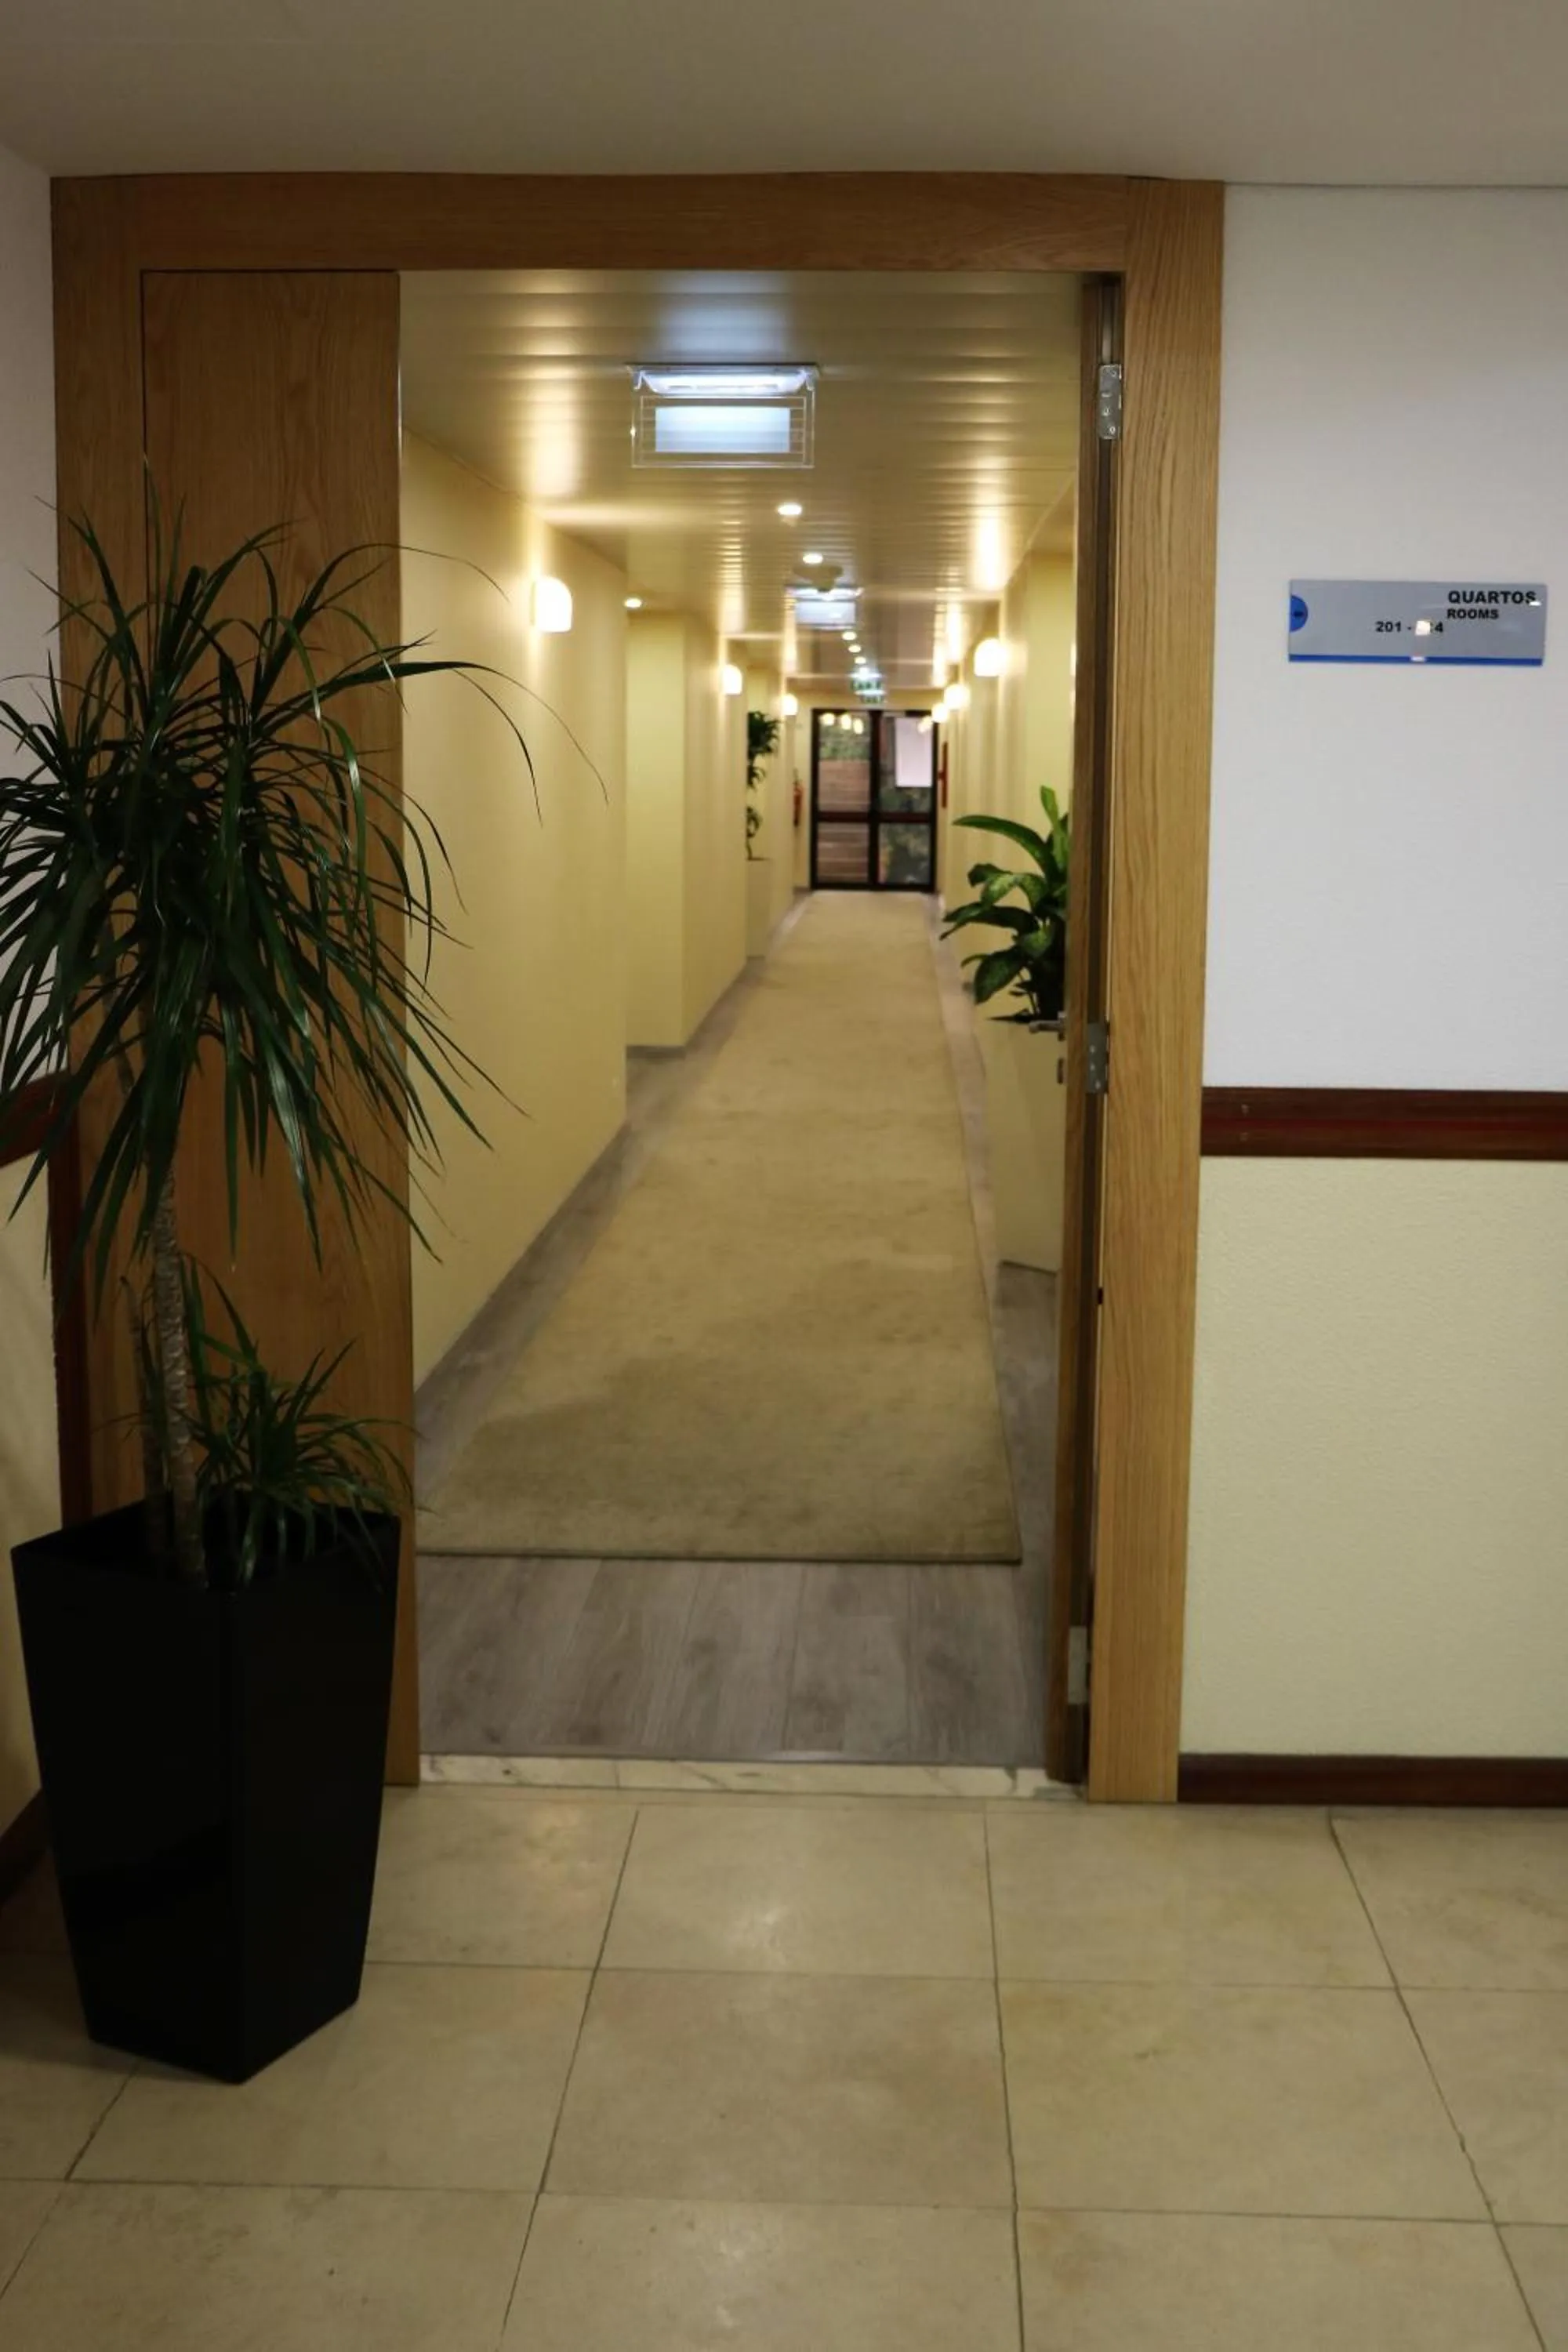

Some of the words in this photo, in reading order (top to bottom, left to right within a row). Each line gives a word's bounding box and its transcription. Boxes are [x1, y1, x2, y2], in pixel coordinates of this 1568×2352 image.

[1447, 590, 1537, 604] QUARTOS
[1446, 608, 1499, 619] ROOMS
[1375, 620, 1401, 633] 201
